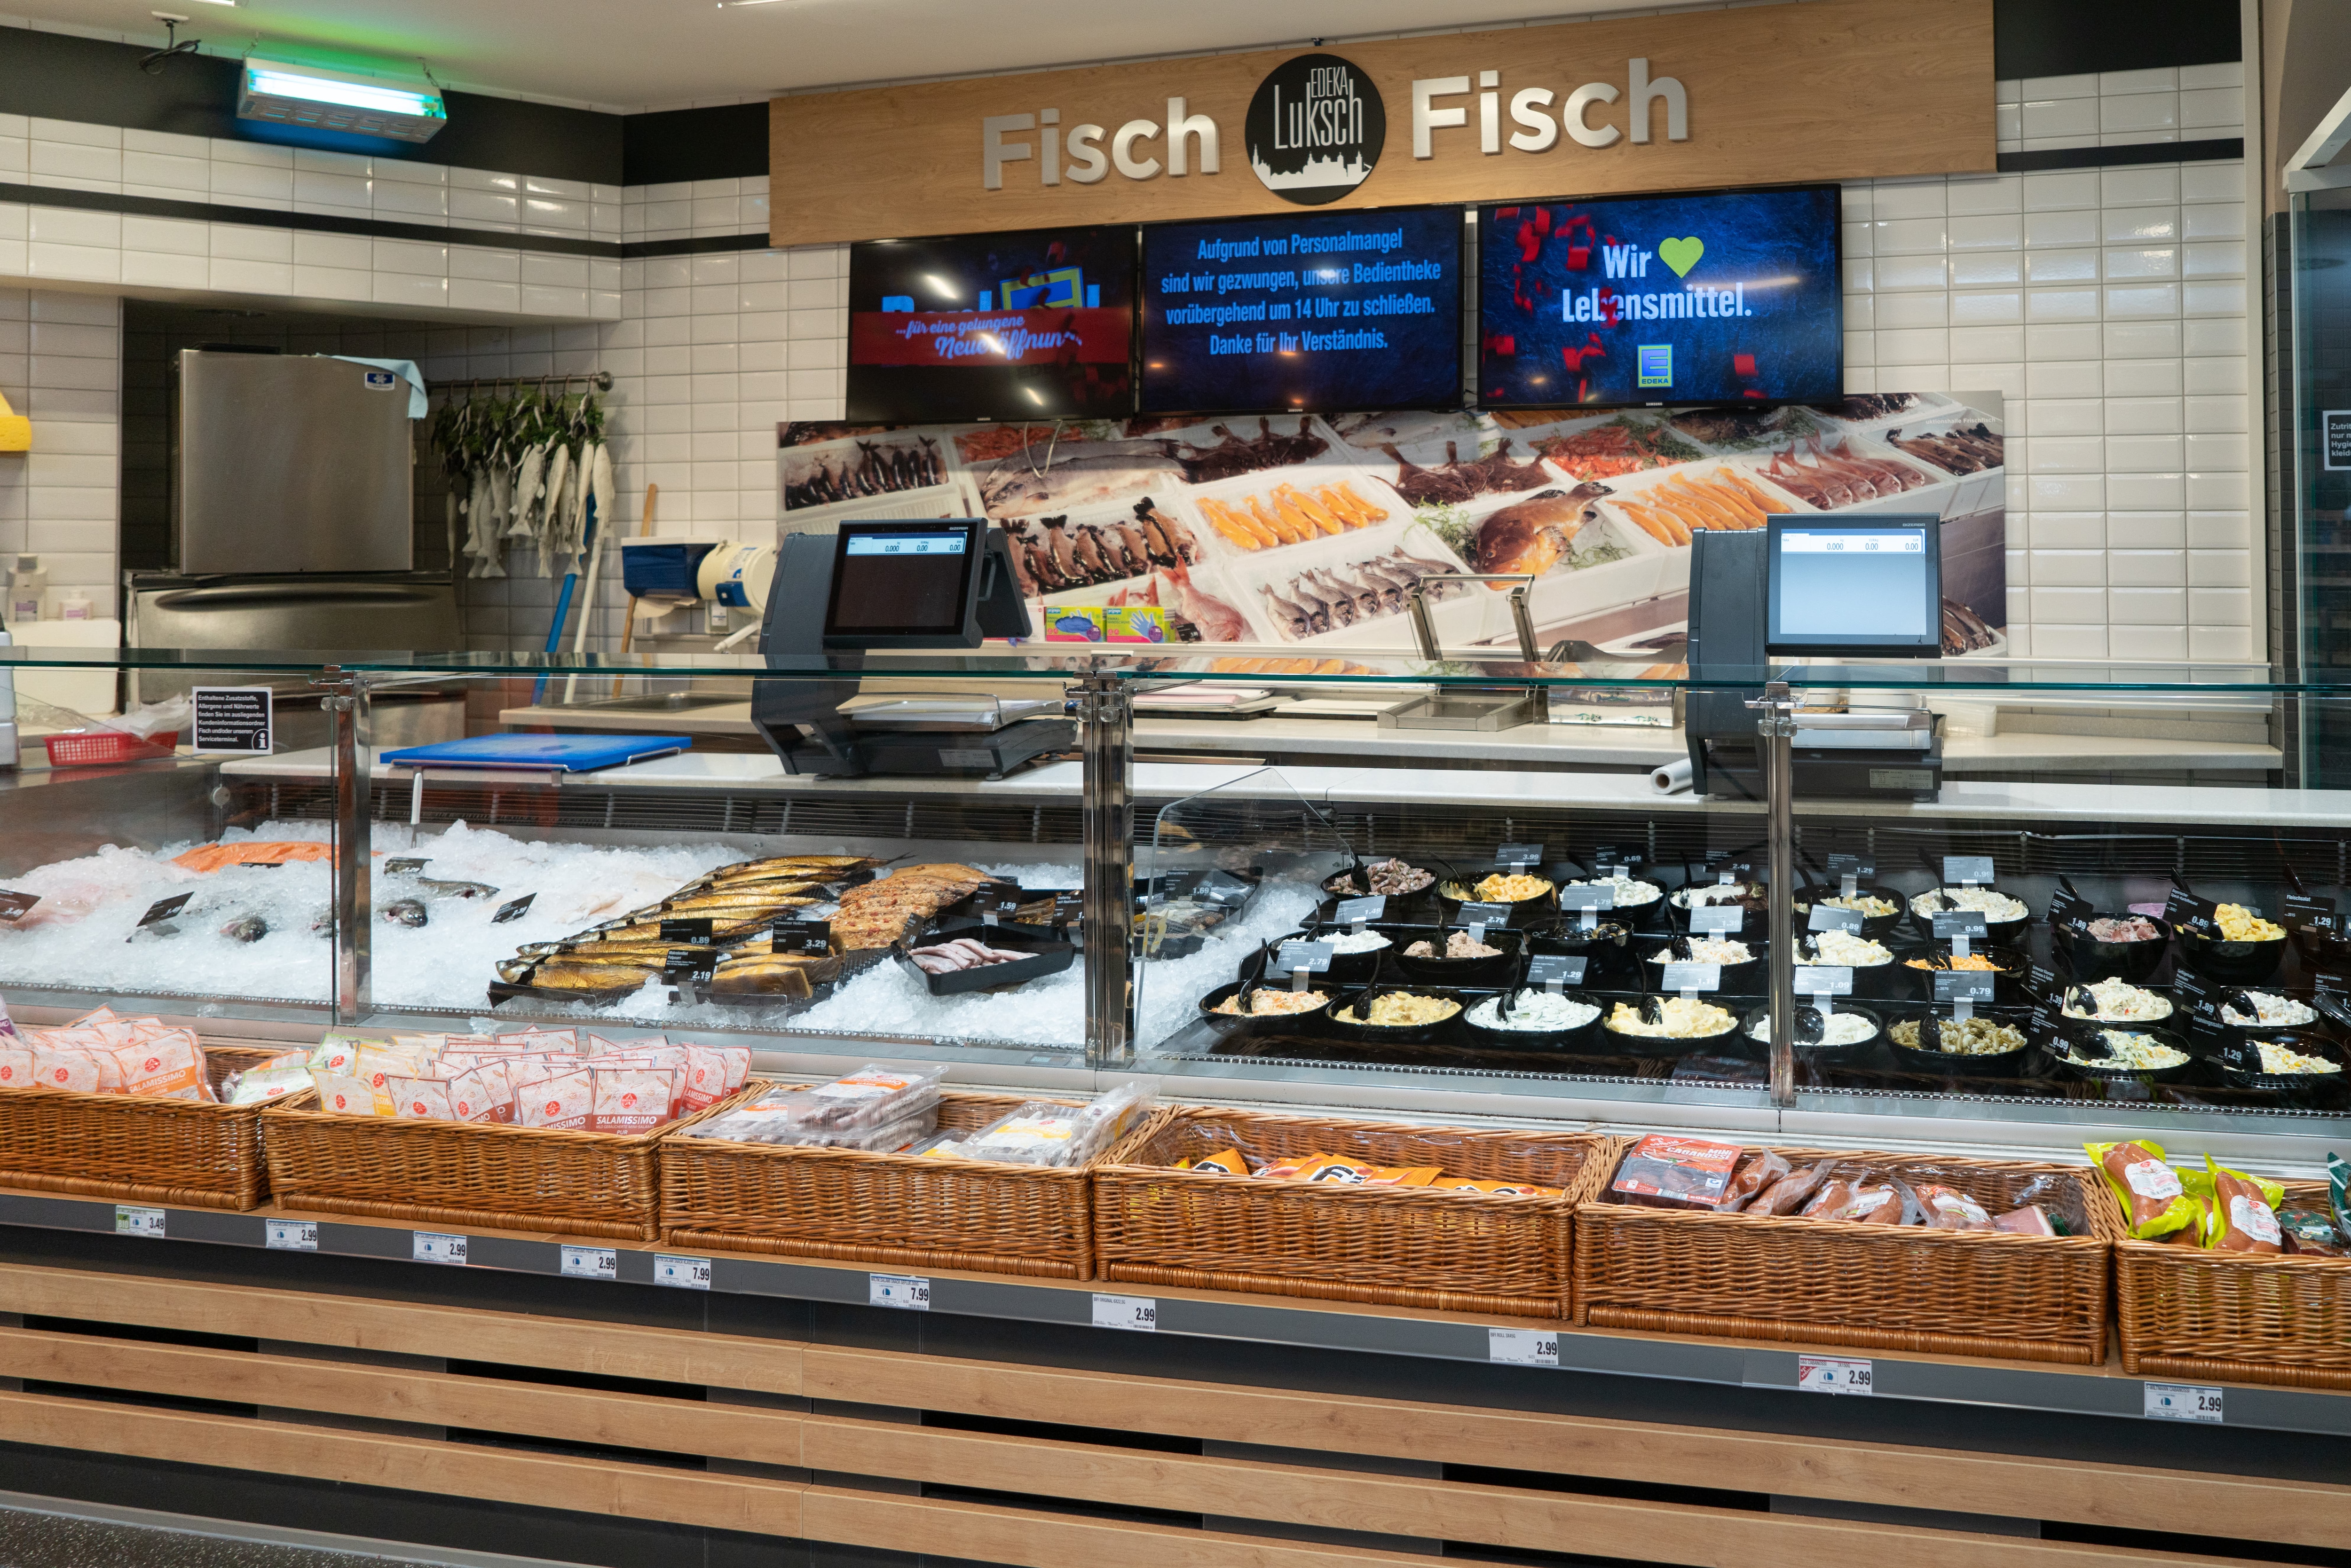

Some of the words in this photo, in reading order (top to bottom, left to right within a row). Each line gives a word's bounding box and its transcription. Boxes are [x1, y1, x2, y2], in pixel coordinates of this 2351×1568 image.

[1310, 67, 1349, 99] EDEKA
[1412, 57, 1688, 161] Fisch
[982, 95, 1219, 189] Fisch
[1198, 236, 1260, 263] Aufgrund
[1263, 238, 1288, 256] von
[1291, 228, 1403, 255] Personalmangel
[1602, 244, 1651, 279] Wir
[1161, 273, 1189, 294] sind
[1193, 272, 1215, 292] wir
[1218, 270, 1299, 294] gezwungen,
[1302, 268, 1350, 286] unsere
[1353, 260, 1441, 284] Bedientheke
[1562, 282, 1752, 323] Lebensmittel.
[1166, 301, 1265, 327] vorübergehend
[1270, 303, 1291, 320] um
[1295, 299, 1312, 318] 14
[1315, 298, 1339, 318] Uhr
[1343, 299, 1359, 317] zu
[1363, 293, 1435, 316] schließen.
[929, 321, 957, 333] eine
[958, 315, 1025, 337] gelungene
[1210, 334, 1253, 355] Danke
[1256, 332, 1275, 353] für
[1279, 331, 1299, 352] Ihr
[1302, 329, 1388, 352] Verständnis.
[1814, 905, 1850, 914] Grillkartoffelsalat
[2072, 917, 2086, 930] 1.89
[2192, 915, 2209, 928] 0.89
[2314, 915, 2331, 925] 1.29
[692, 970, 712, 979] 2.19
[2050, 993, 2063, 1005] 1.39
[2199, 1000, 2214, 1013] 1.89
[2193, 1015, 2224, 1029] Frühlingssalat
[2052, 1036, 2068, 1050] 0.99
[2223, 1047, 2242, 1061] 1.29
[129, 1070, 186, 1094] SALAMISSIMO
[596, 1116, 657, 1125] SALAMISSIMO
[1666, 1147, 1730, 1160] CABANOSSI
[118, 1219, 129, 1229] BIO
[150, 1217, 164, 1230] 3.49
[301, 1229, 316, 1242] 2.99
[450, 1243, 465, 1256] 2.99
[599, 1256, 615, 1270] 2.99
[693, 1267, 710, 1281] 7.99
[911, 1287, 929, 1301] 7.99
[1136, 1307, 1154, 1322] 2.99
[1537, 1341, 1557, 1355] 2.99
[1849, 1370, 1870, 1385] 2.99
[2198, 1395, 2222, 1411] 2.99
